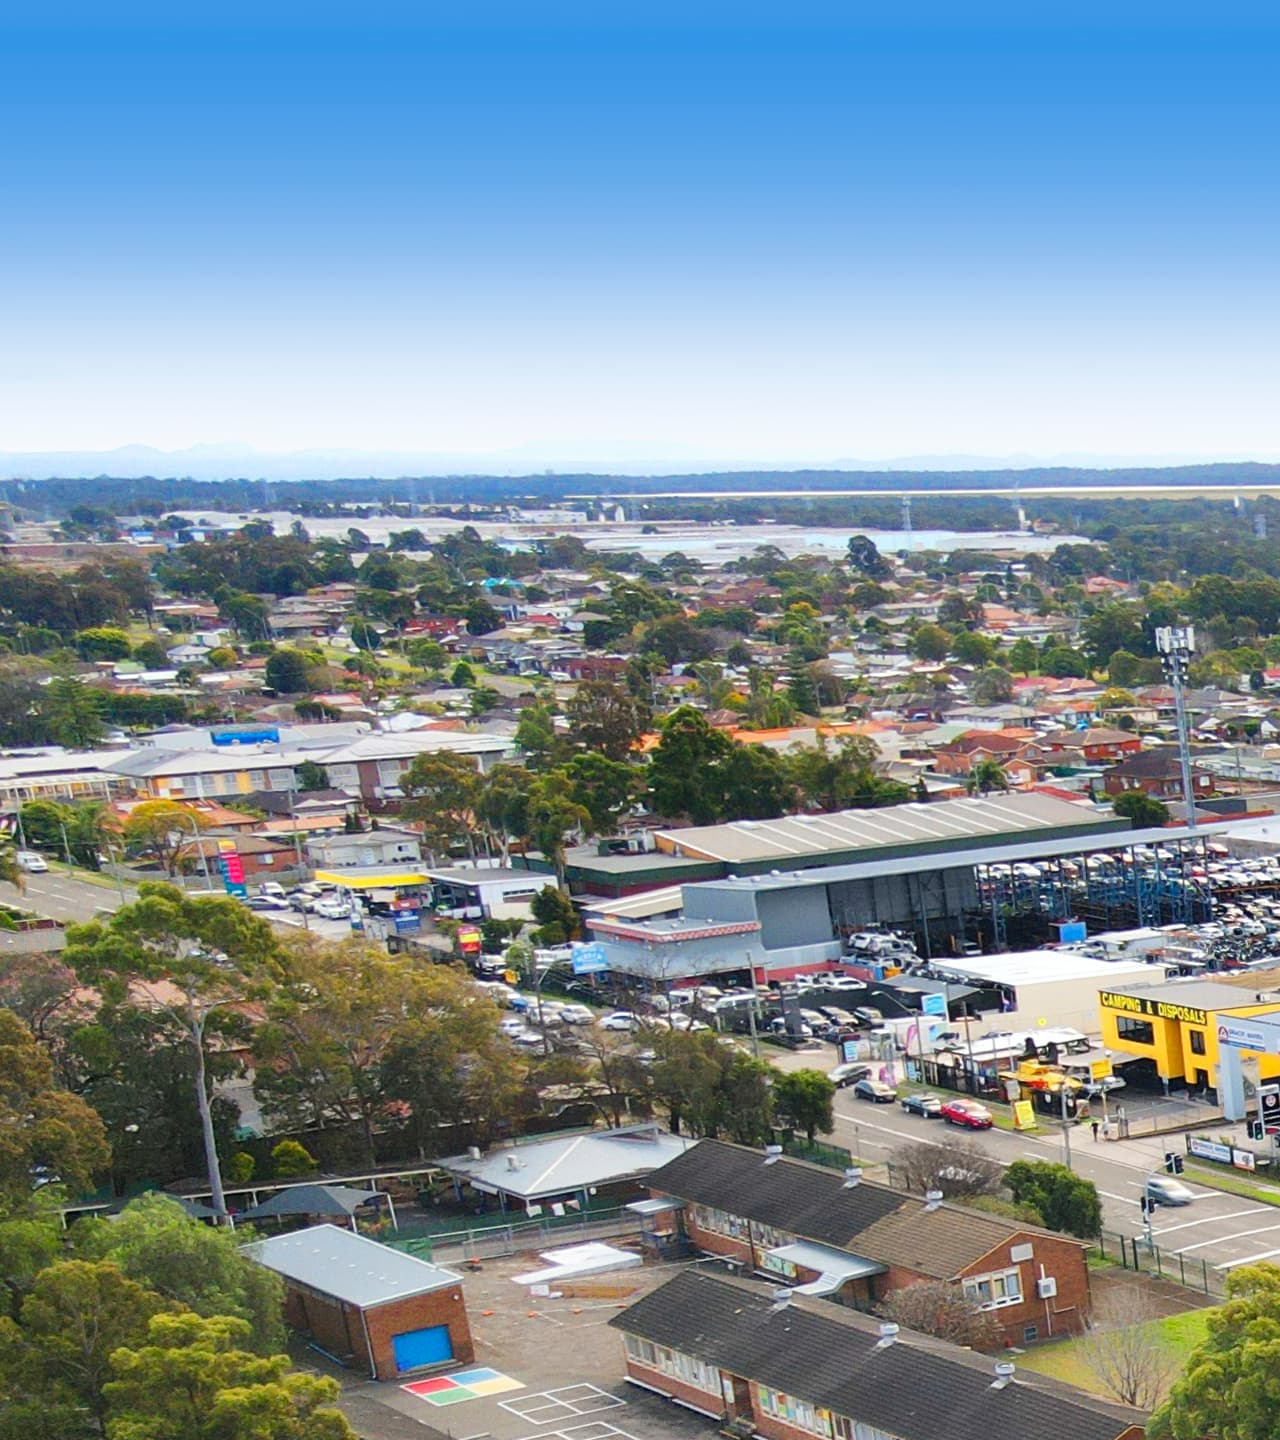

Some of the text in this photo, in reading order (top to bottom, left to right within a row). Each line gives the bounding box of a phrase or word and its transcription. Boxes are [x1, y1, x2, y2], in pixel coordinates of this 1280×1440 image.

[1102, 993, 1206, 1024] CAMPING & DISPOSALS
